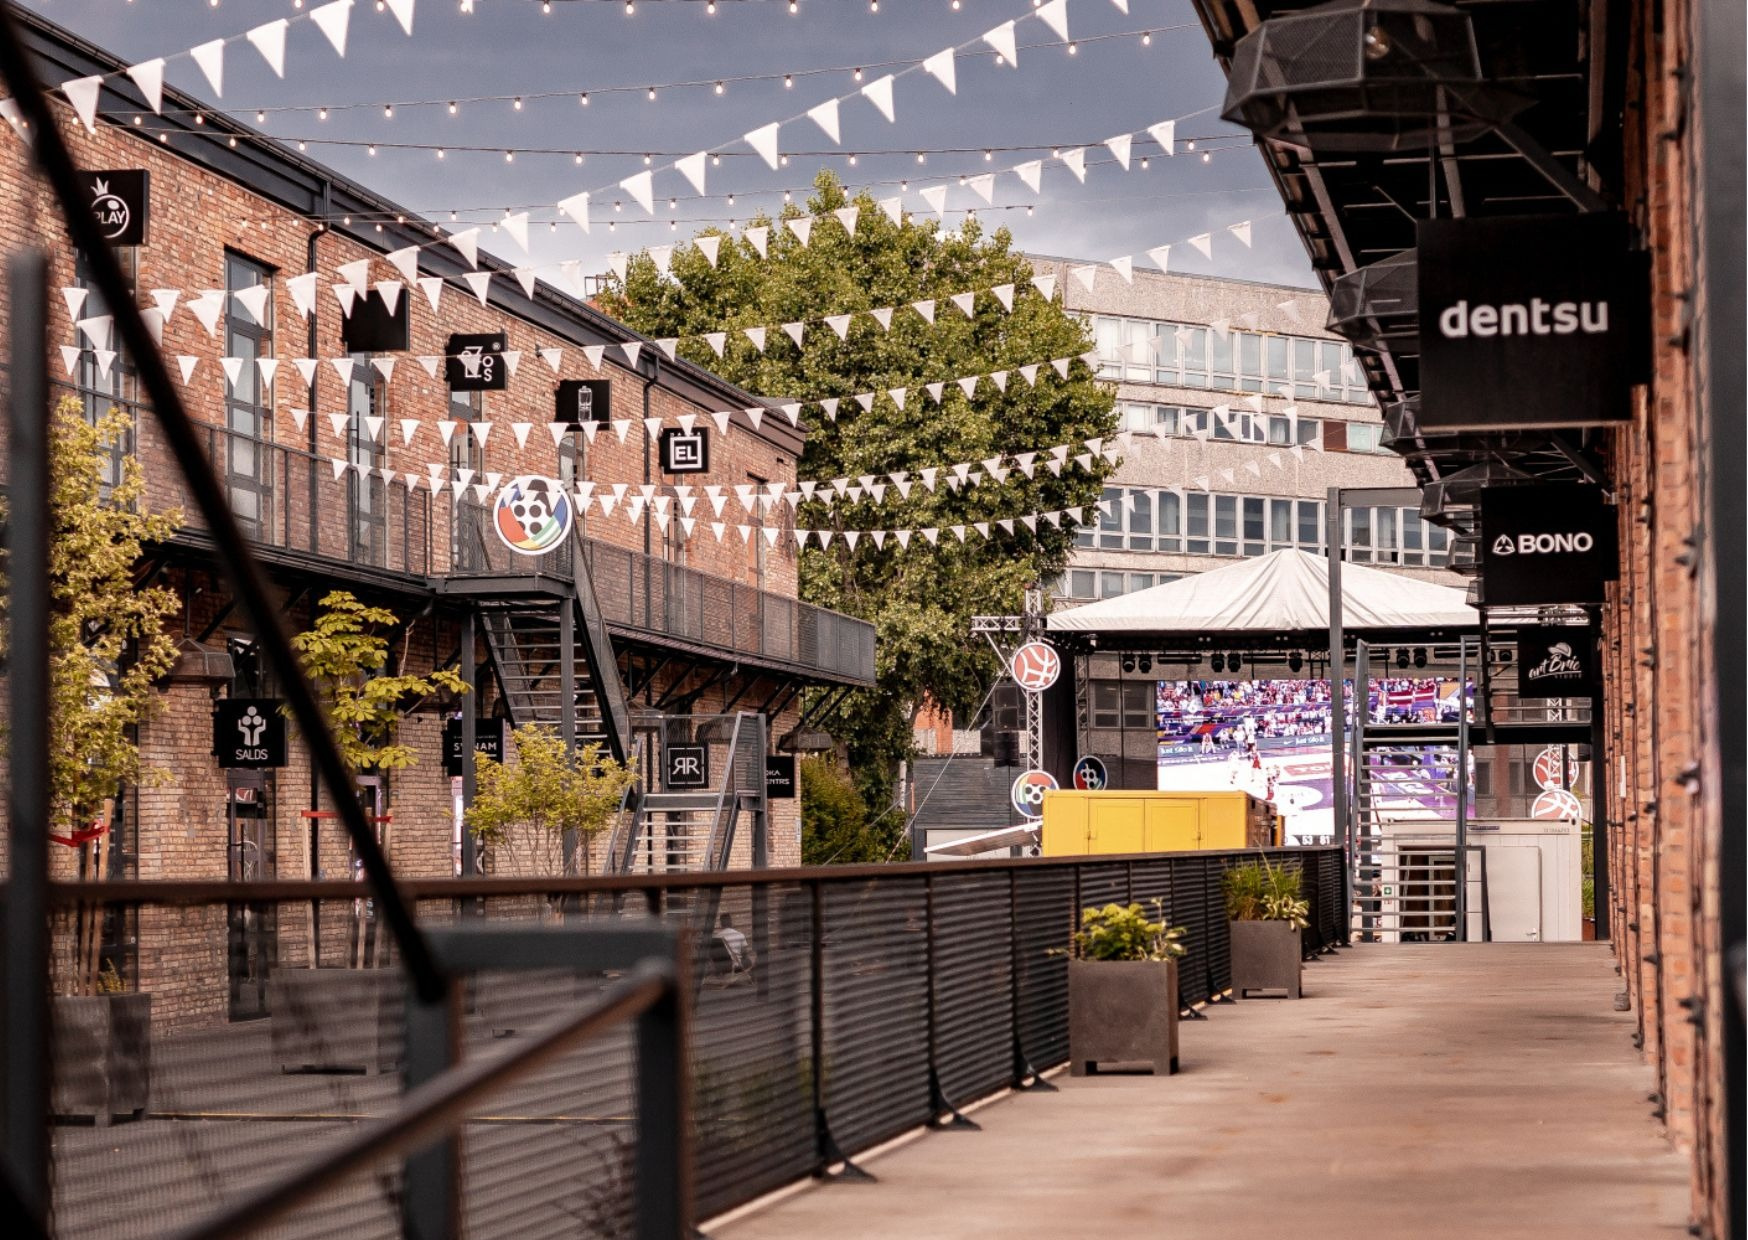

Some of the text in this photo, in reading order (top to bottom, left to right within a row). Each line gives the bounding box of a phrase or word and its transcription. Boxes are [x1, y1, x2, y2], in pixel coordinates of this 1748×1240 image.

[1439, 298, 1609, 338] dentsu
[674, 445, 697, 461] EL
[1517, 532, 1594, 554] BONO
[235, 748, 269, 761] SALDS
